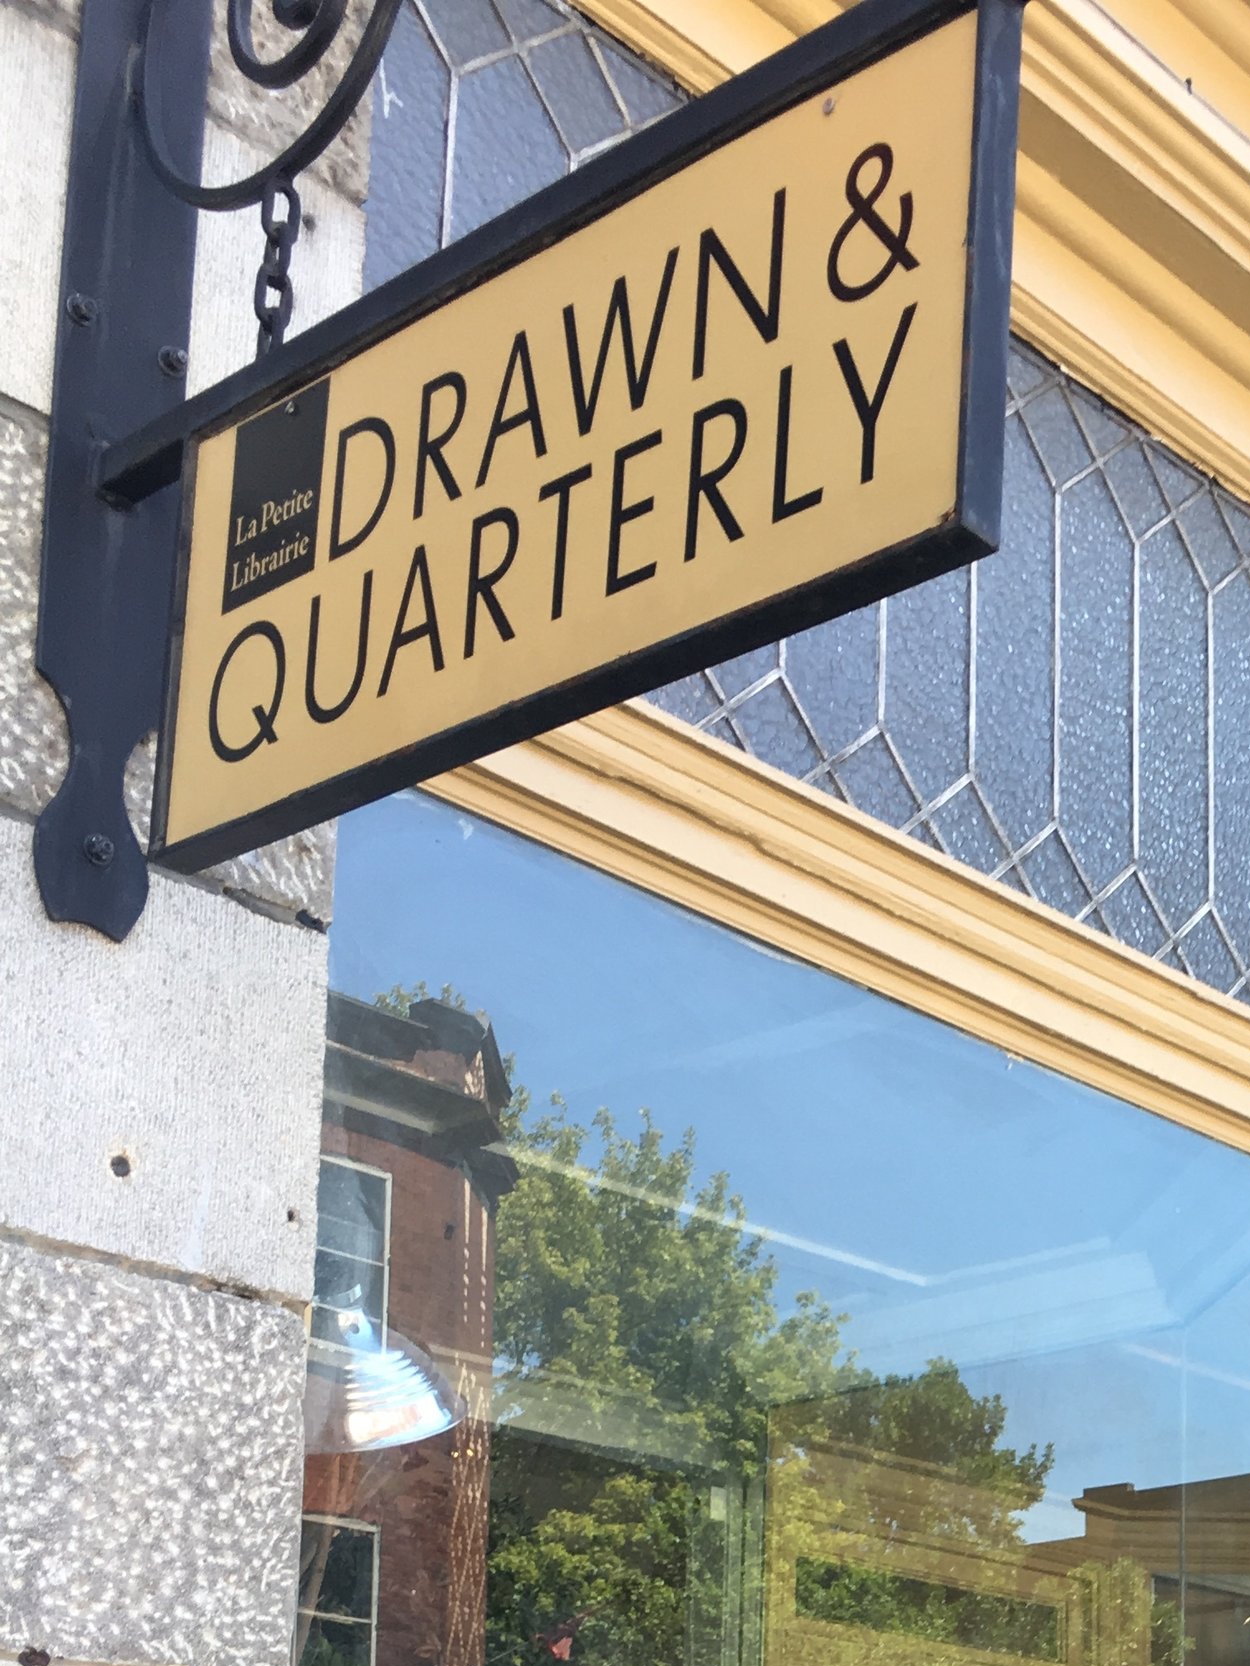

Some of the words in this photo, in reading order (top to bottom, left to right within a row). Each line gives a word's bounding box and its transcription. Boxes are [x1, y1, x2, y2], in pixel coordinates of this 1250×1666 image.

[328, 188, 786, 562] DRAWN
[826, 142, 922, 303] &
[208, 302, 917, 763] QUARTERLY
[230, 531, 310, 592] Librairie
[234, 515, 257, 547] La
[261, 488, 313, 533] Petite
